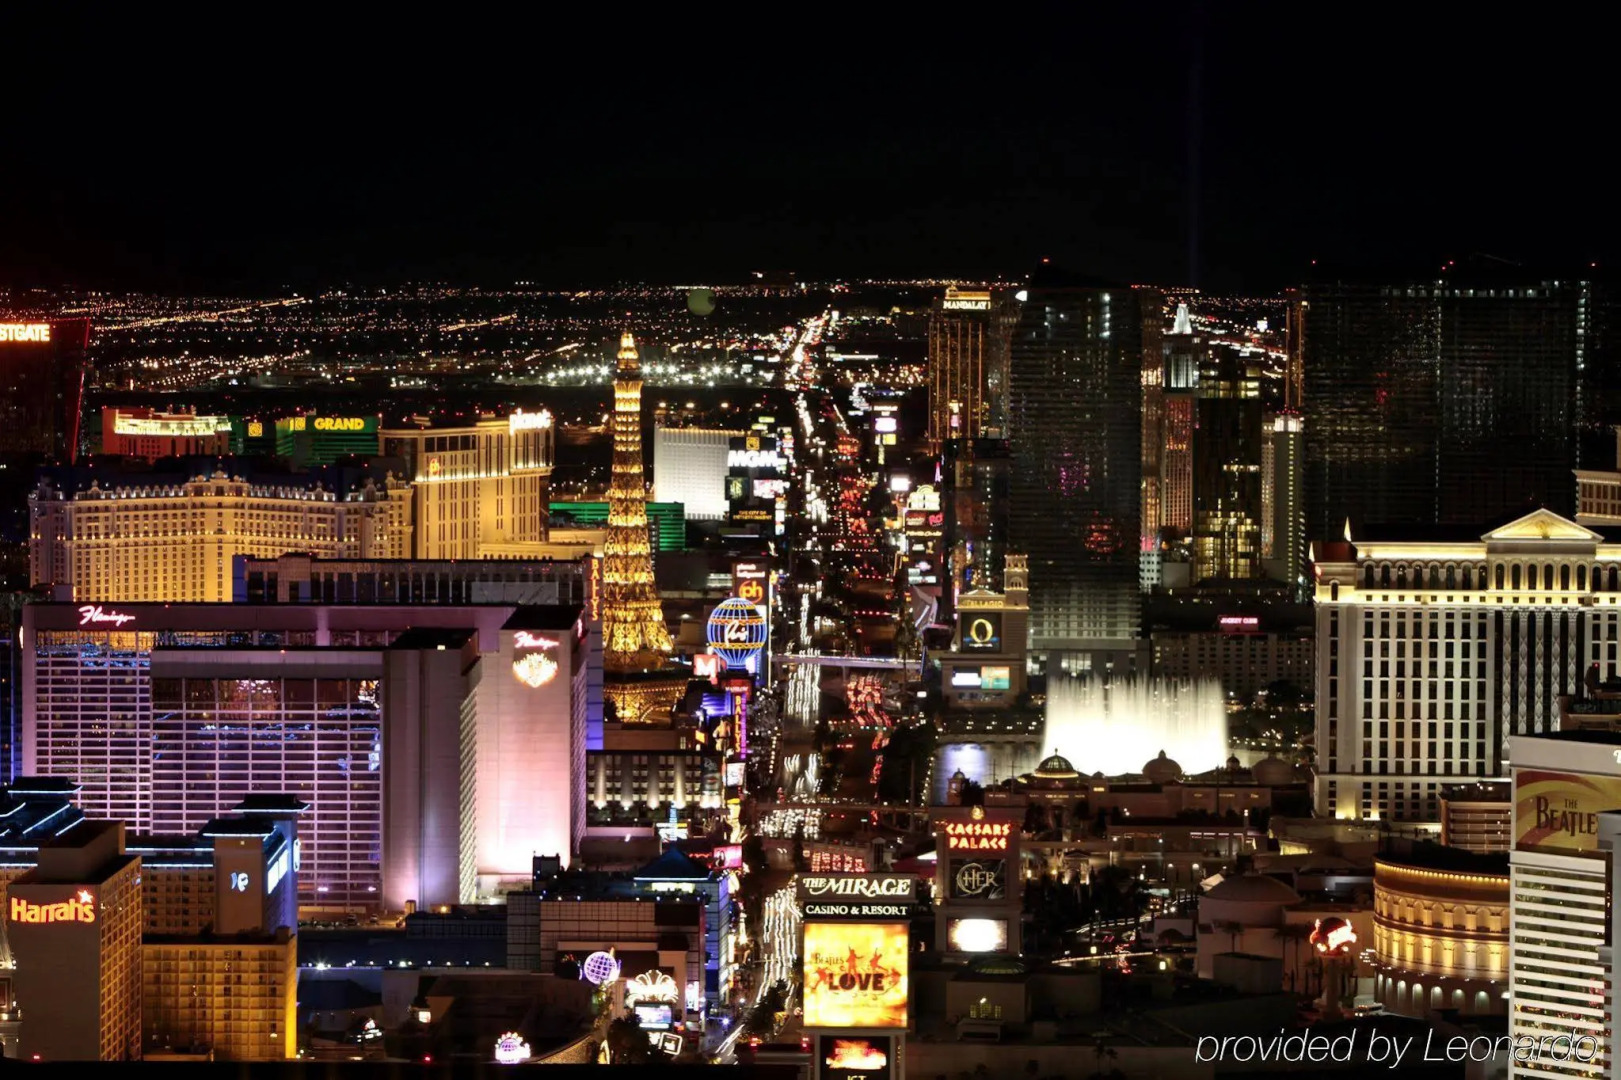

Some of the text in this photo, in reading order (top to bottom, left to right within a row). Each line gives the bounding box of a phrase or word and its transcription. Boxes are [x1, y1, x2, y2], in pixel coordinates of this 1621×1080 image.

[314, 417, 365, 430] GRAND
[728, 450, 778, 468] MGM
[78, 605, 136, 627] Flamingo
[1564, 798, 1579, 809] THE
[1536, 795, 1599, 837] BEATLE
[946, 823, 1011, 836] CAESARS
[949, 837, 1007, 849] PALACE
[957, 863, 999, 894] CHER
[803, 878, 912, 898] THE MIRAGE
[805, 905, 908, 915] CASINO & RESORT
[828, 972, 885, 991] LOVE
